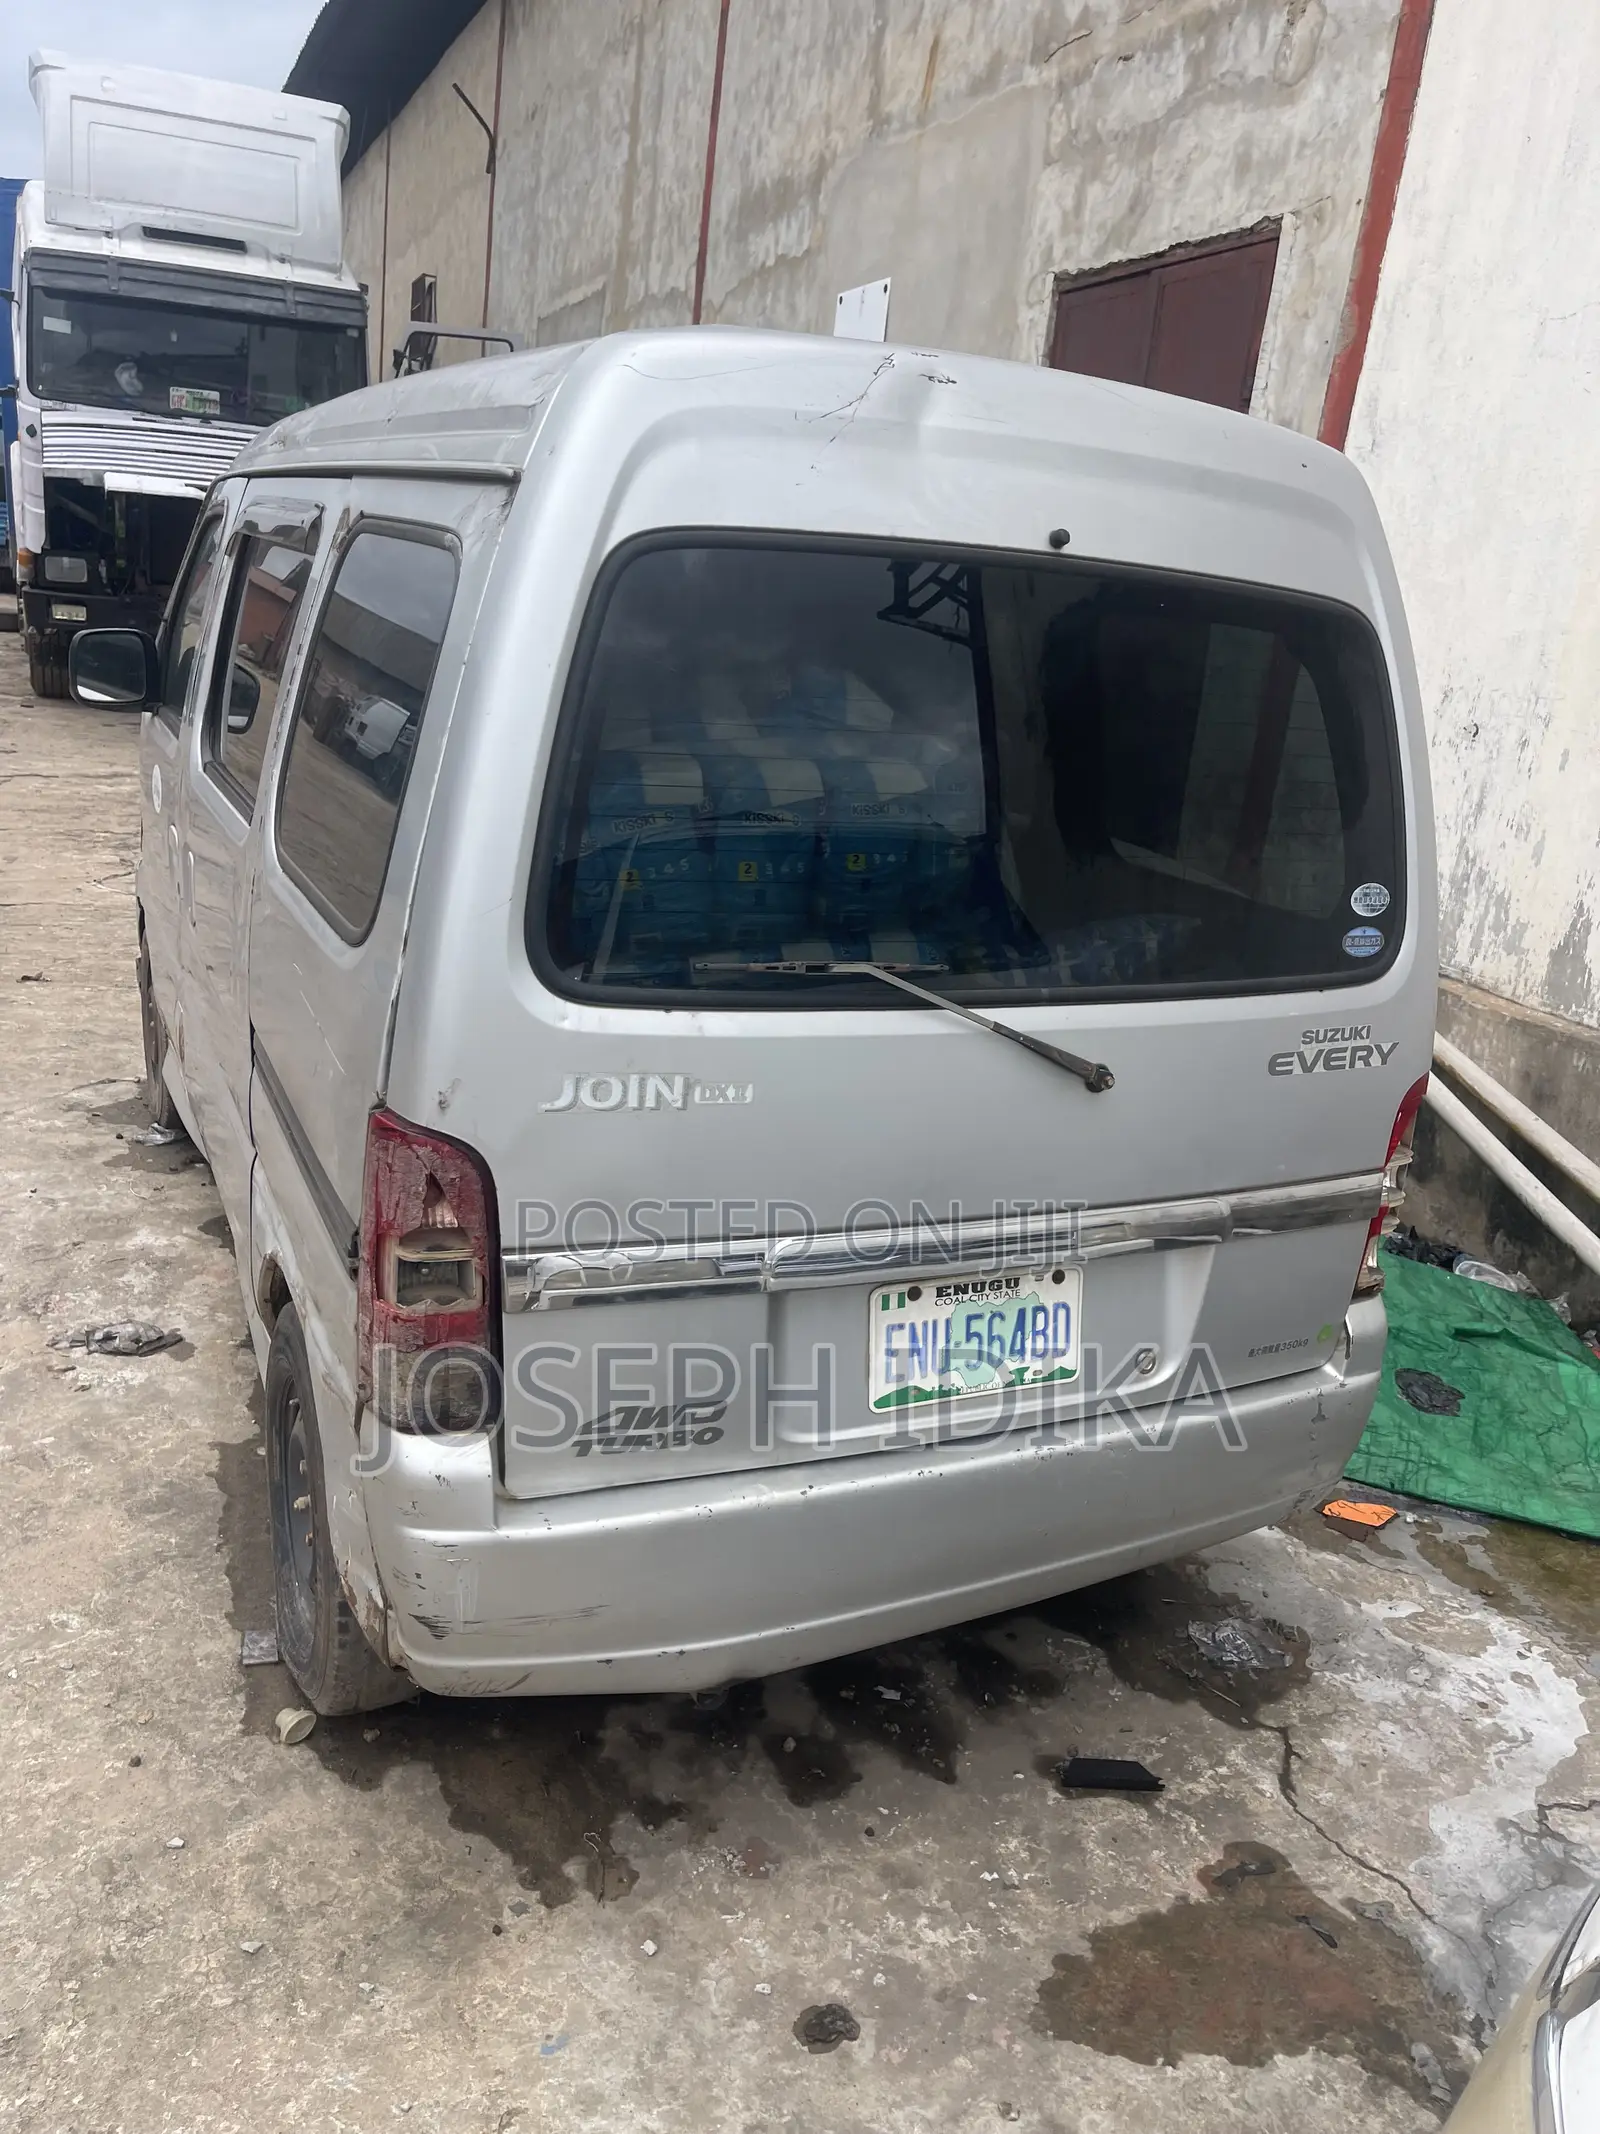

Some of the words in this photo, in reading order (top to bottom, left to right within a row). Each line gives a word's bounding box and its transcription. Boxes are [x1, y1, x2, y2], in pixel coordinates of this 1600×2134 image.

[744, 862, 753, 875] 2
[852, 854, 861, 865] 2
[625, 870, 636, 883] 2
[1301, 1025, 1371, 1045] SUZUKI
[1267, 1041, 1399, 1076] EVERY
[538, 1073, 691, 1112] JOIN
[935, 1296, 967, 1306] COAL
[969, 1292, 991, 1302] CITY
[993, 1289, 1020, 1300] STATE
[936, 1277, 1020, 1298] ENUGU
[576, 1400, 728, 1435] 4WD
[571, 1427, 725, 1458] TURBO
